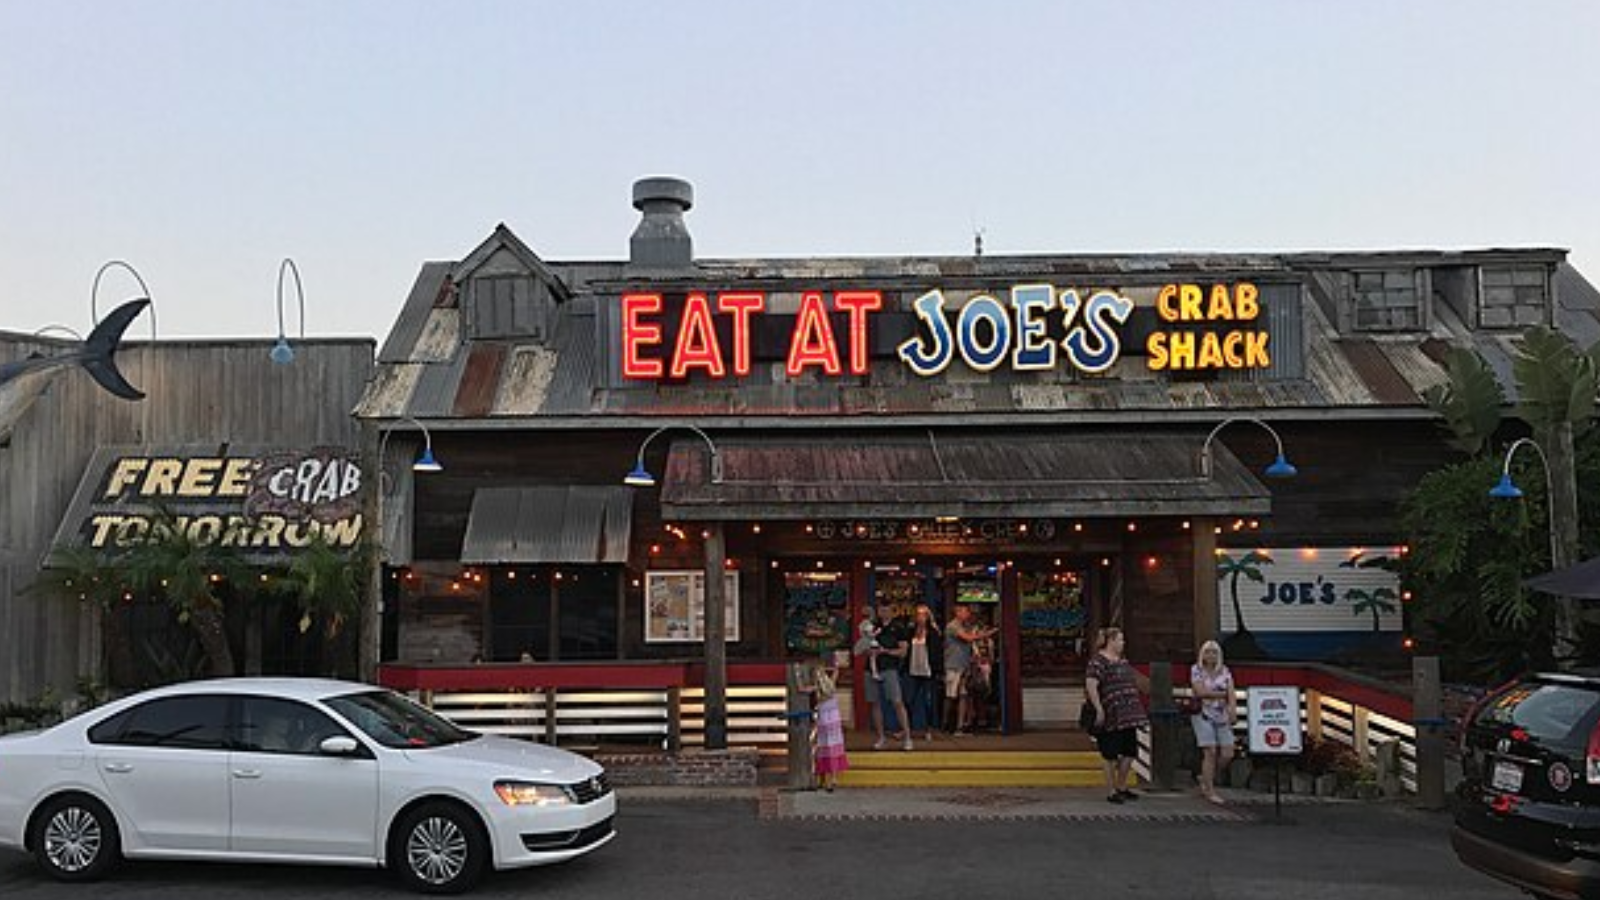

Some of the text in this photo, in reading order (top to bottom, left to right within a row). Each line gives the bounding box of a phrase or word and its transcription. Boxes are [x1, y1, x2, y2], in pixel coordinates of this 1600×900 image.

[1157, 284, 1260, 322] CRAB
[621, 283, 1135, 379] EAT AT JOE'S
[1146, 331, 1270, 370] SHACK
[105, 458, 363, 504] FREE CRAB
[1260, 575, 1336, 604] JOE'S
